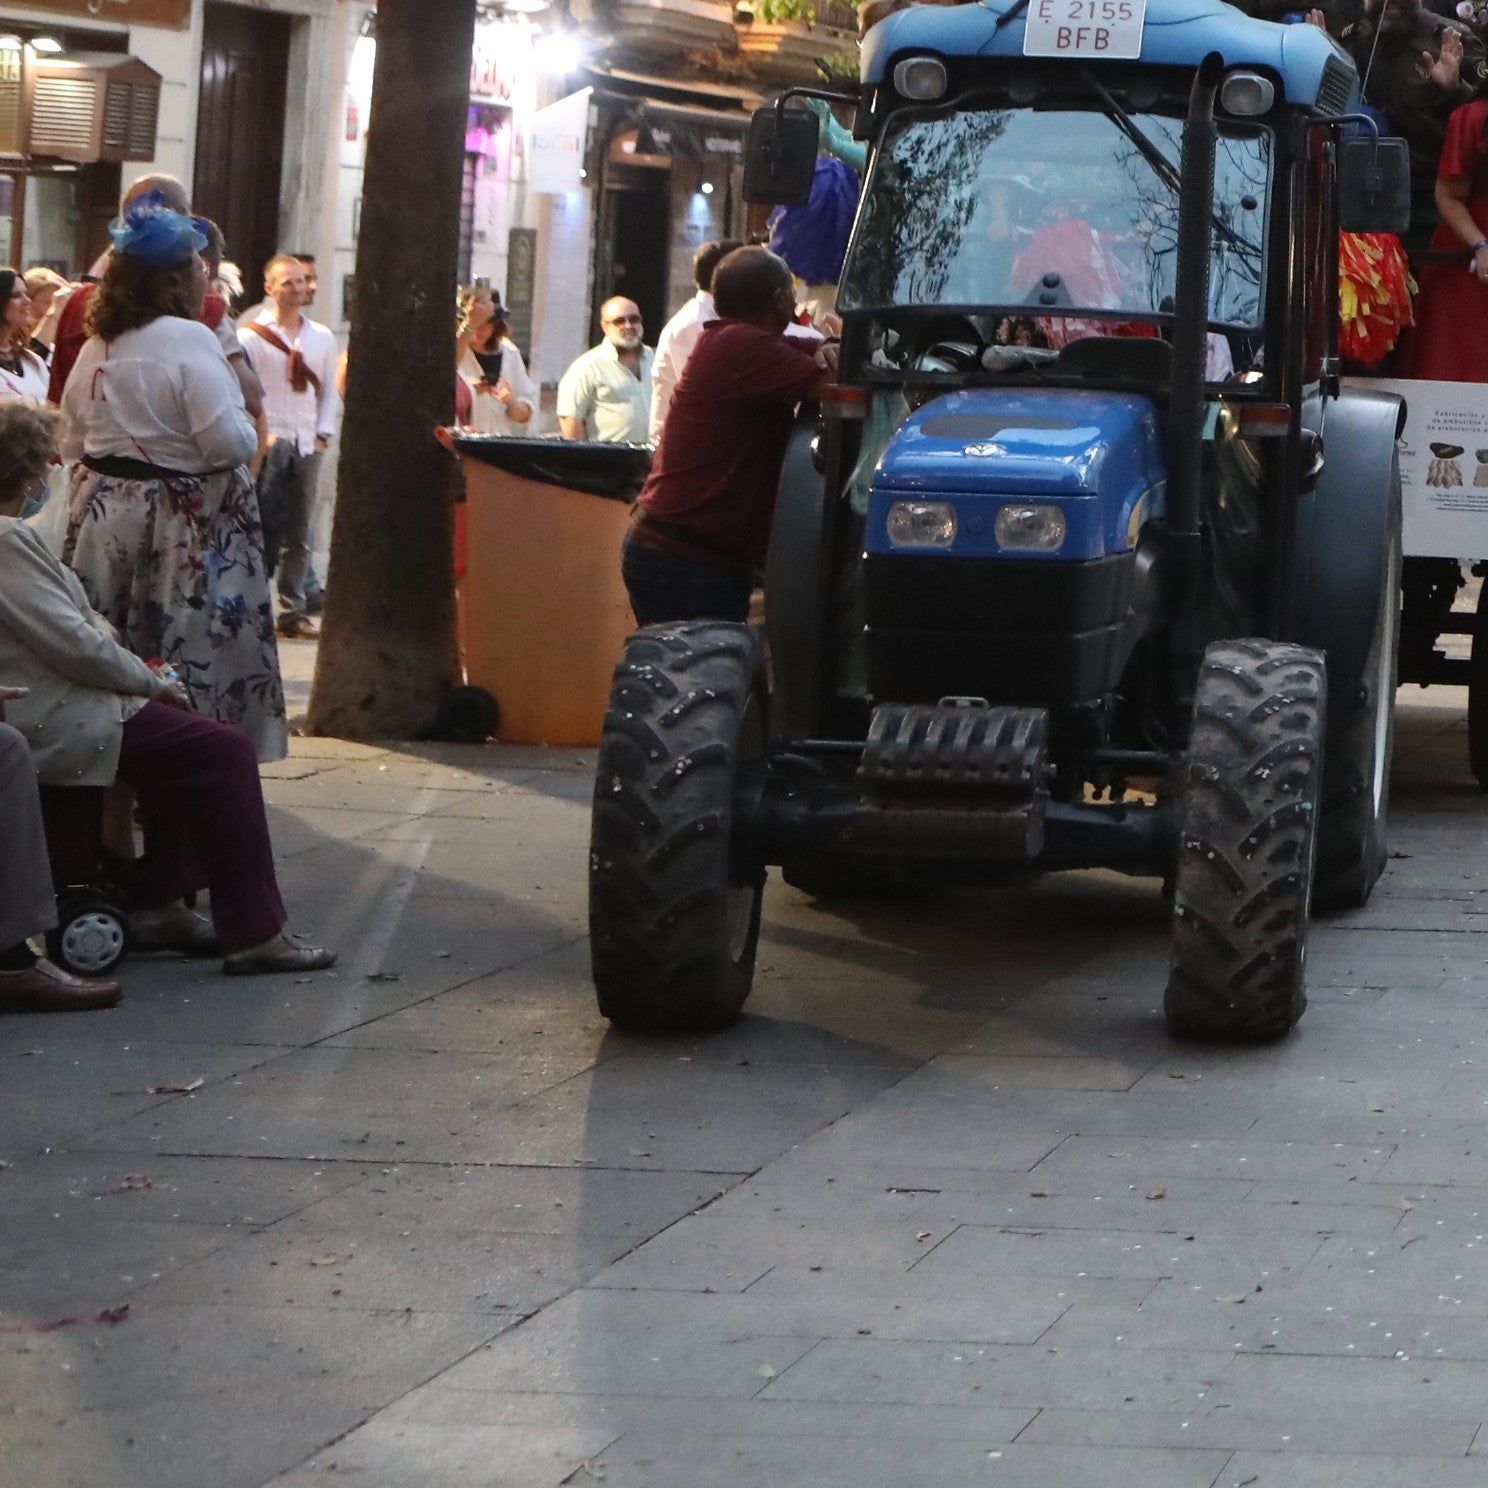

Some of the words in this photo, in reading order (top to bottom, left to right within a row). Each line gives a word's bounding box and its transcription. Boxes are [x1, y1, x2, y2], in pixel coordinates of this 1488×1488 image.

[1038, 0, 1055, 18] E
[1067, 0, 1133, 21] 2155
[1056, 26, 1110, 51] BFB
